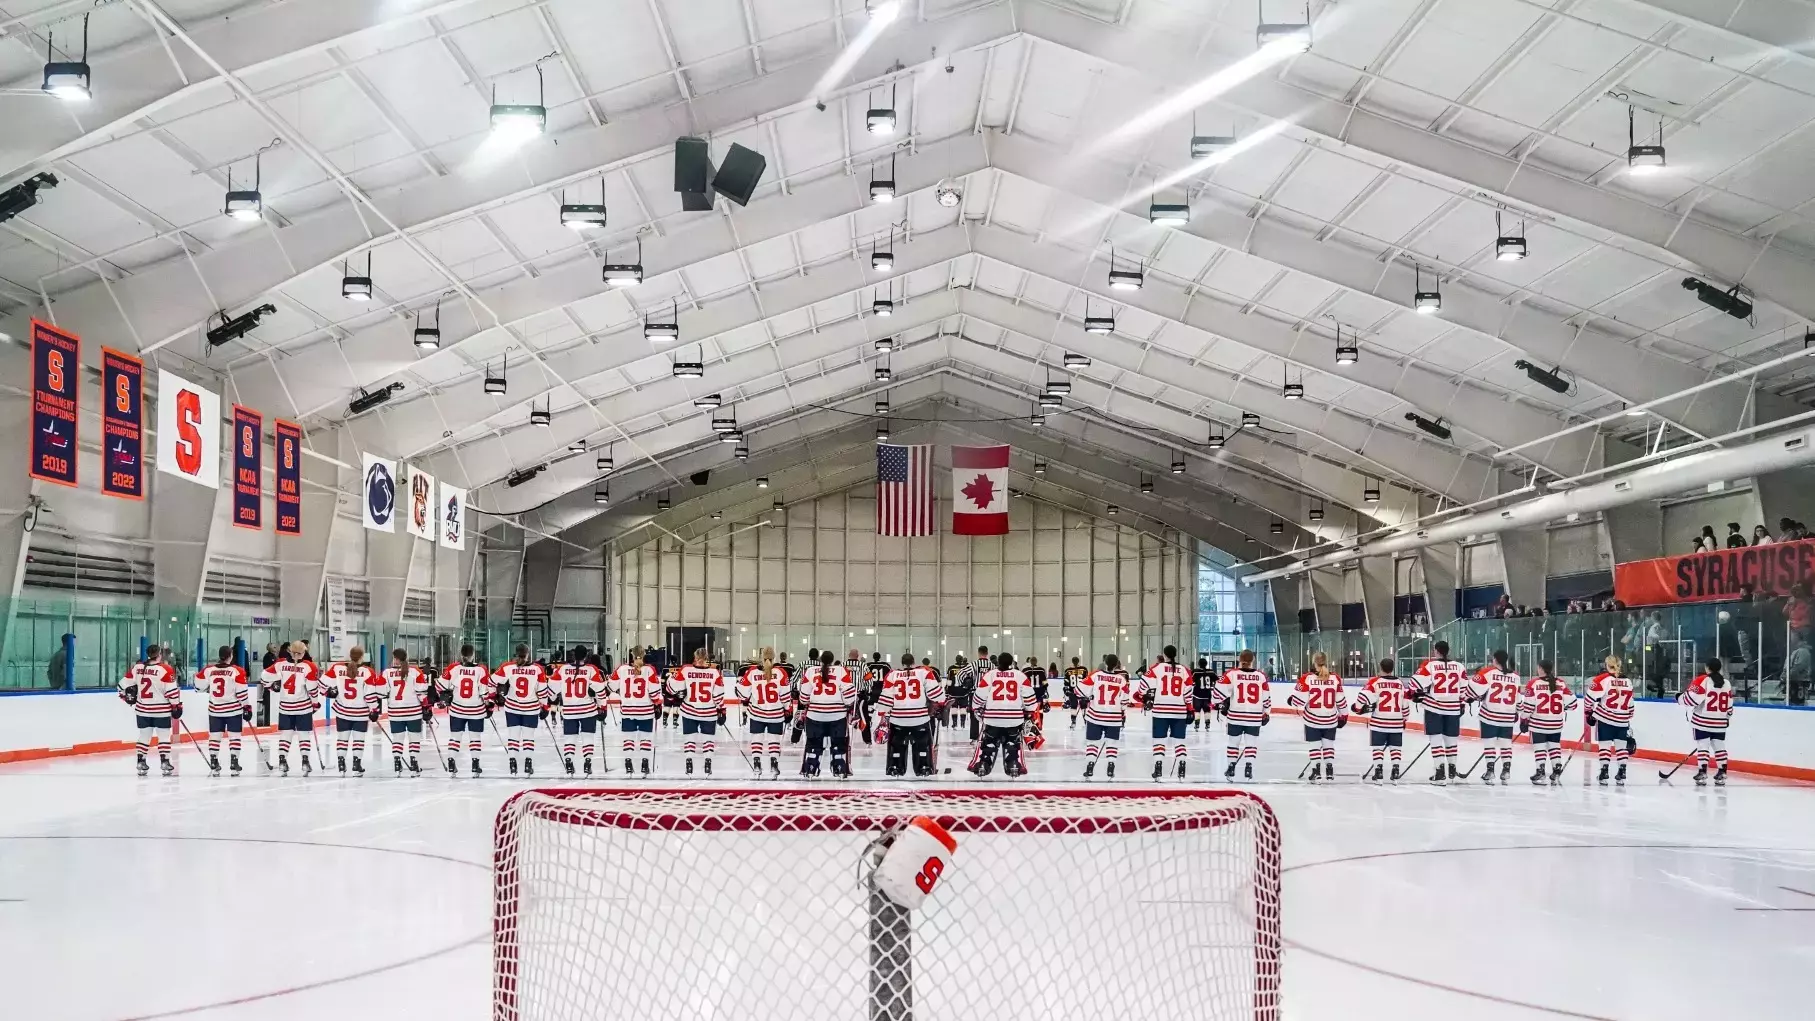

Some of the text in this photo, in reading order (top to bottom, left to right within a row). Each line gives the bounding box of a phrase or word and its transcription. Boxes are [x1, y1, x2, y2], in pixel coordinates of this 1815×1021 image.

[48, 349, 64, 392] S
[36, 390, 75, 411] TOURNAMENT
[116, 373, 130, 413] S
[35, 402, 76, 422] CHAMPIONS
[105, 424, 139, 440] CHAMPIONS
[176, 388, 202, 476] S
[242, 425, 254, 458] S
[42, 454, 68, 475] 2019
[283, 438, 293, 469] S
[112, 472, 135, 490] 2022
[239, 467, 257, 485] NCAA
[240, 507, 256, 521] 2019
[281, 515, 296, 528] 2022
[1676, 543, 1815, 599] SYRACUSE
[283, 673, 297, 695] 4
[813, 674, 837, 696] 35
[872, 668, 884, 682] 31
[1160, 675, 1182, 697] 18
[1199, 676, 1211, 689] 19
[1433, 672, 1459, 694] 22
[140, 677, 154, 699] 2
[212, 677, 226, 698] 3
[344, 678, 358, 700] 5
[393, 679, 406, 701] 7
[459, 678, 473, 699] 8
[515, 677, 529, 698] 9
[564, 677, 588, 699] 10
[624, 677, 647, 699] 13
[689, 681, 712, 703] 15
[756, 682, 779, 704] 16
[894, 678, 921, 700] 33
[992, 679, 1018, 701] 29
[1098, 684, 1121, 705] 17
[1237, 683, 1260, 704] 19
[1309, 687, 1336, 709] 20
[1489, 682, 1517, 705] 23
[1378, 690, 1401, 712] 21
[1536, 692, 1563, 715] 26
[1605, 688, 1633, 710] 27
[1707, 691, 1729, 713] 28
[915, 856, 944, 895] S
